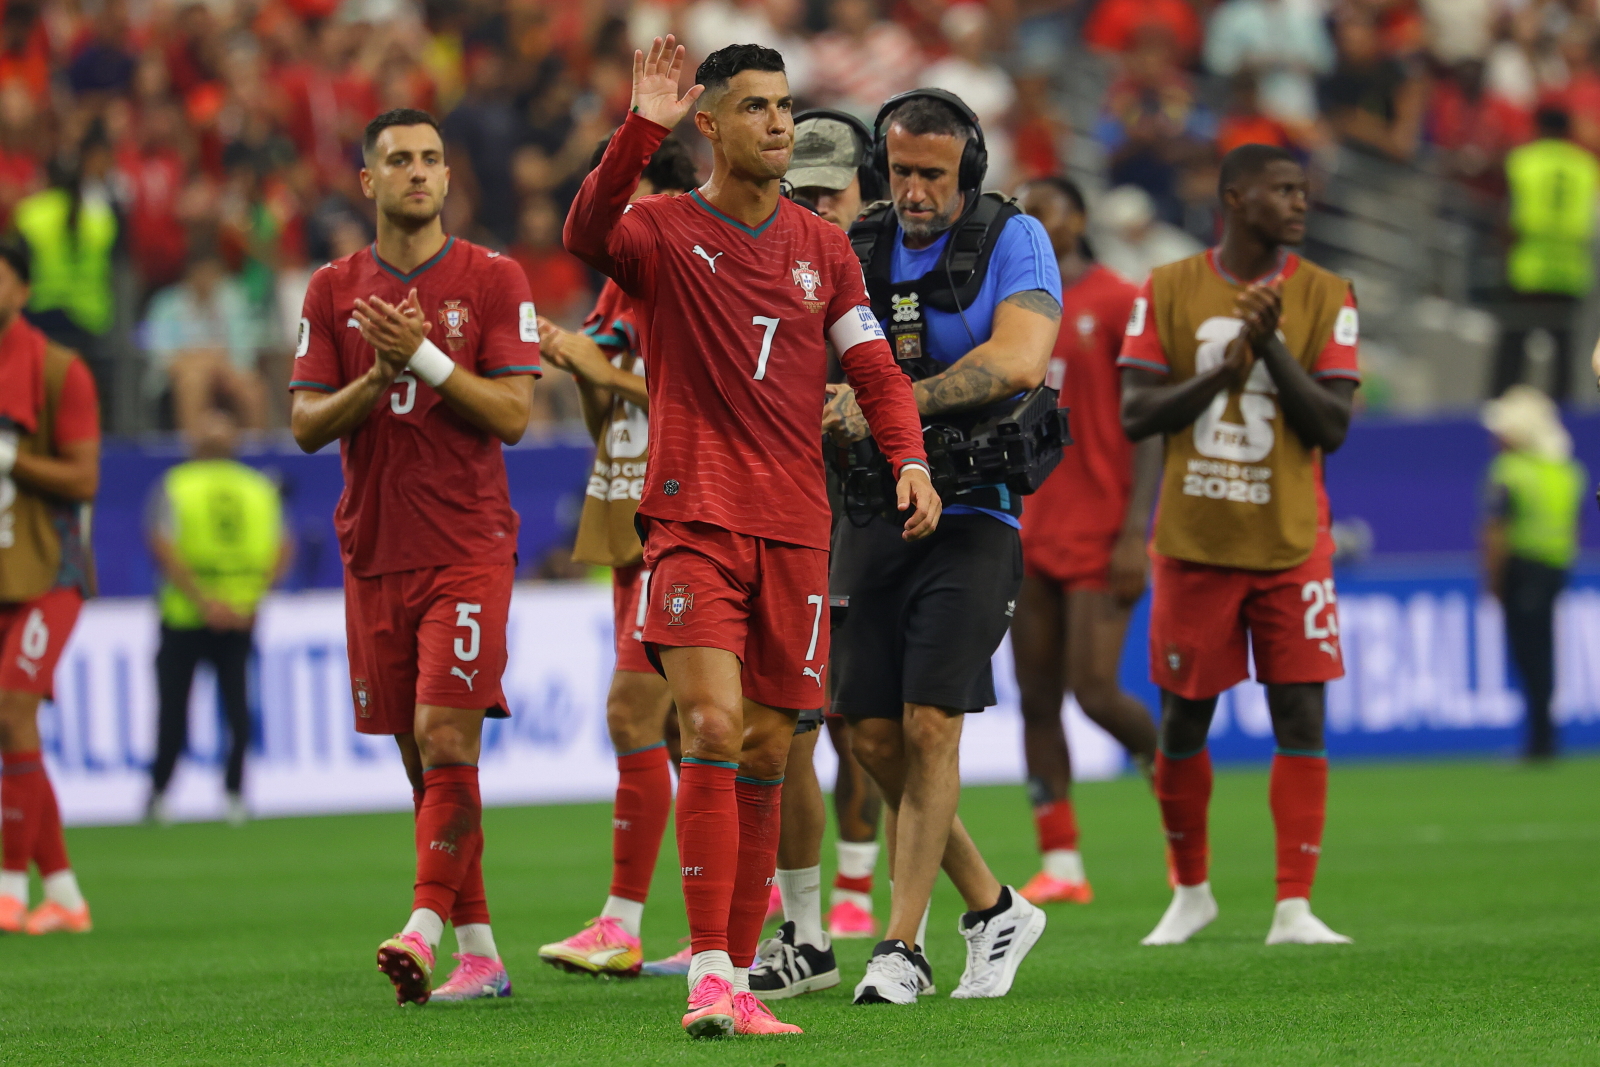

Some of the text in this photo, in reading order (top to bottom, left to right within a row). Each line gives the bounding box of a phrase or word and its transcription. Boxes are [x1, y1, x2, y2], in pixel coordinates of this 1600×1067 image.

[752, 315, 781, 381] 7
[390, 367, 417, 415] 5
[1183, 474, 1271, 505] 2026
[21, 608, 49, 660] 6
[454, 602, 481, 661] 5
[805, 595, 823, 660] 7
